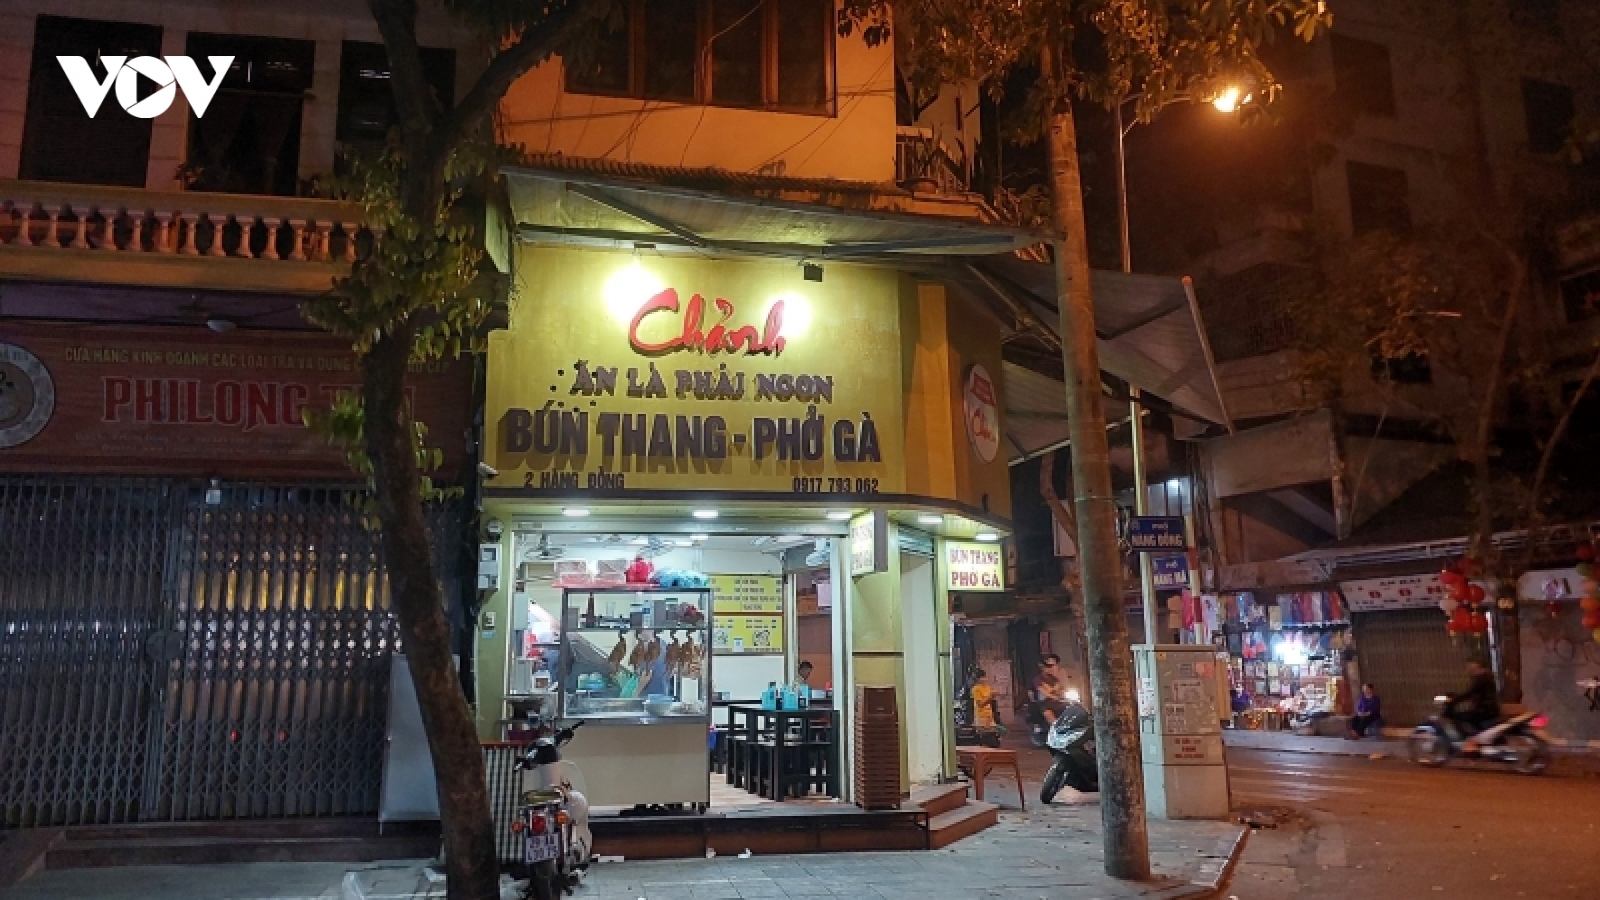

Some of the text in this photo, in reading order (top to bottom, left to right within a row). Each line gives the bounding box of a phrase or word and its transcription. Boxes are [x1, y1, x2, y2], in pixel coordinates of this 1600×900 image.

[629, 287, 787, 358] Chảnh
[626, 362, 668, 398] LÀ
[675, 362, 746, 401] PHẢI
[753, 373, 834, 404] NGON
[504, 399, 589, 458] BÚN
[597, 413, 728, 464] THANG
[752, 404, 825, 464] PHỞ
[833, 412, 882, 464] GÀ
[524, 472, 534, 488] 2
[540, 468, 579, 489] HÀNG
[793, 477, 823, 493] 0917
[828, 477, 852, 493] 793
[969, 549, 999, 565] THANG
[951, 567, 1001, 587] PHỞ GÀ
